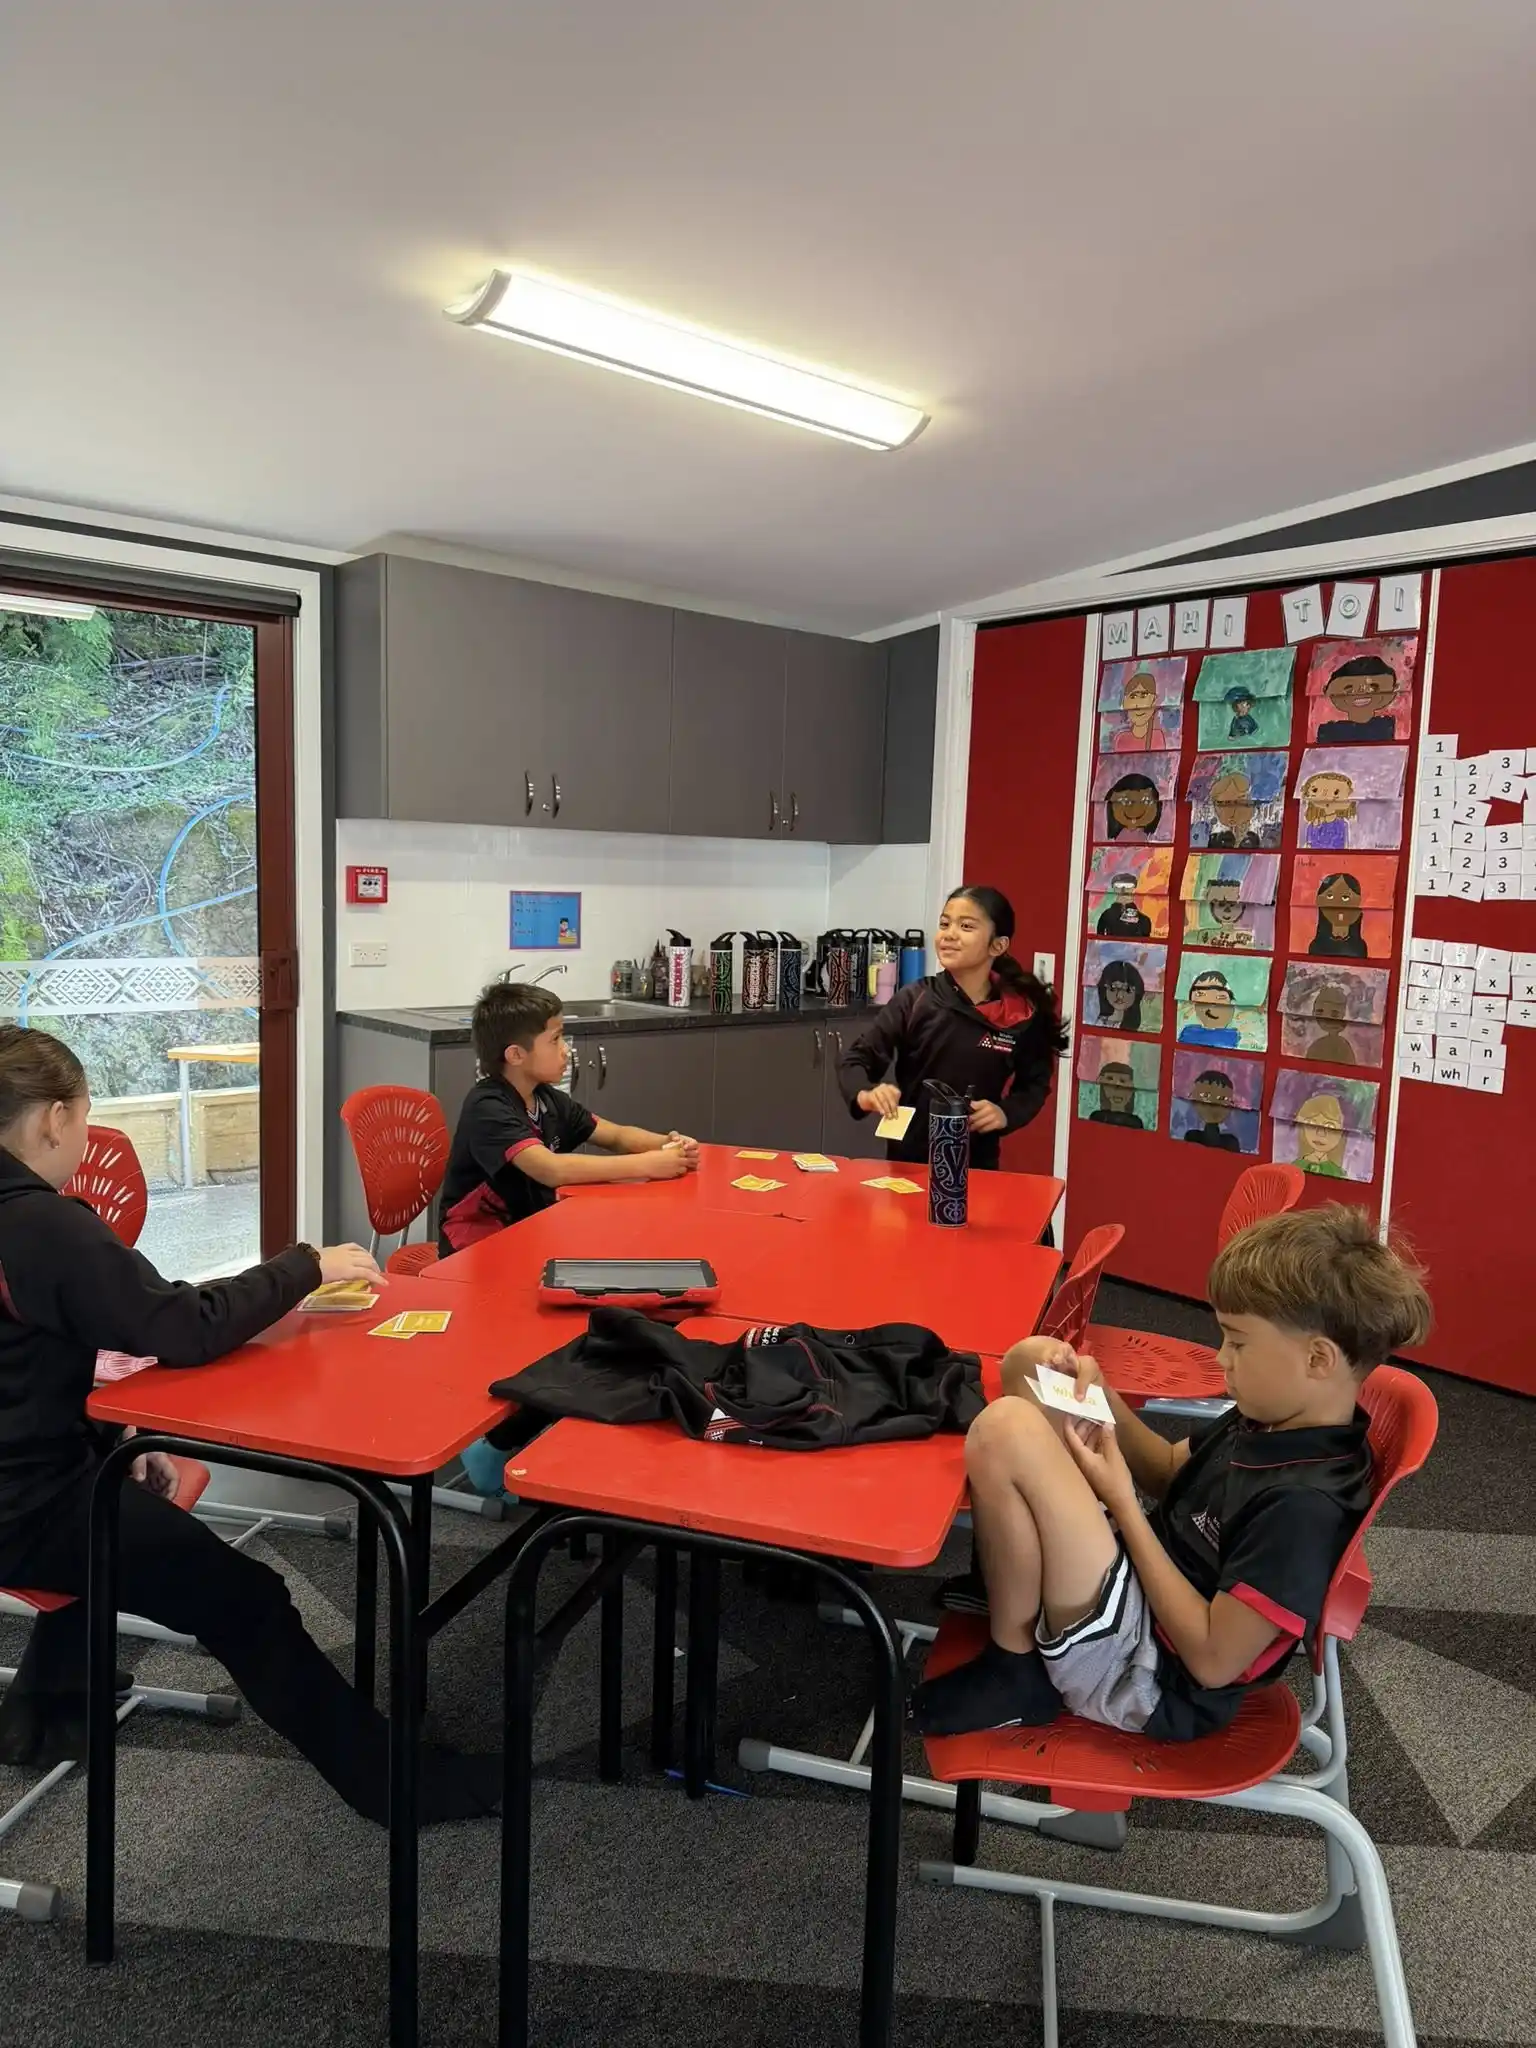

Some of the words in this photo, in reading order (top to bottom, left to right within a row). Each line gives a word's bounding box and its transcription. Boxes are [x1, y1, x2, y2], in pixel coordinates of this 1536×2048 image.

[1107, 609, 1234, 646] MAHI
[1291, 587, 1405, 623] TOI
[1435, 741, 1444, 753] 1
[1434, 765, 1443, 777] 1
[1468, 763, 1478, 776] 2
[1501, 756, 1511, 769] 3
[1433, 785, 1442, 798] 1
[1467, 783, 1477, 795] 2
[1501, 781, 1512, 794] 3
[1432, 807, 1441, 820] 1
[1465, 806, 1476, 819] 2
[1430, 831, 1439, 843] 1
[1463, 832, 1473, 844] 2
[1499, 831, 1509, 844] 3
[1429, 855, 1437, 867] 1
[1462, 856, 1472, 869] 2
[1498, 856, 1508, 869] 3
[1428, 879, 1436, 890] 1
[1461, 881, 1471, 894] 2
[1497, 881, 1507, 894] 3
[1410, 1043, 1422, 1052] w
[1448, 1046, 1458, 1056] a
[1483, 1048, 1493, 1059] n
[1412, 1061, 1421, 1075] h
[1440, 1068, 1461, 1081] wh
[1482, 1076, 1490, 1086] r
